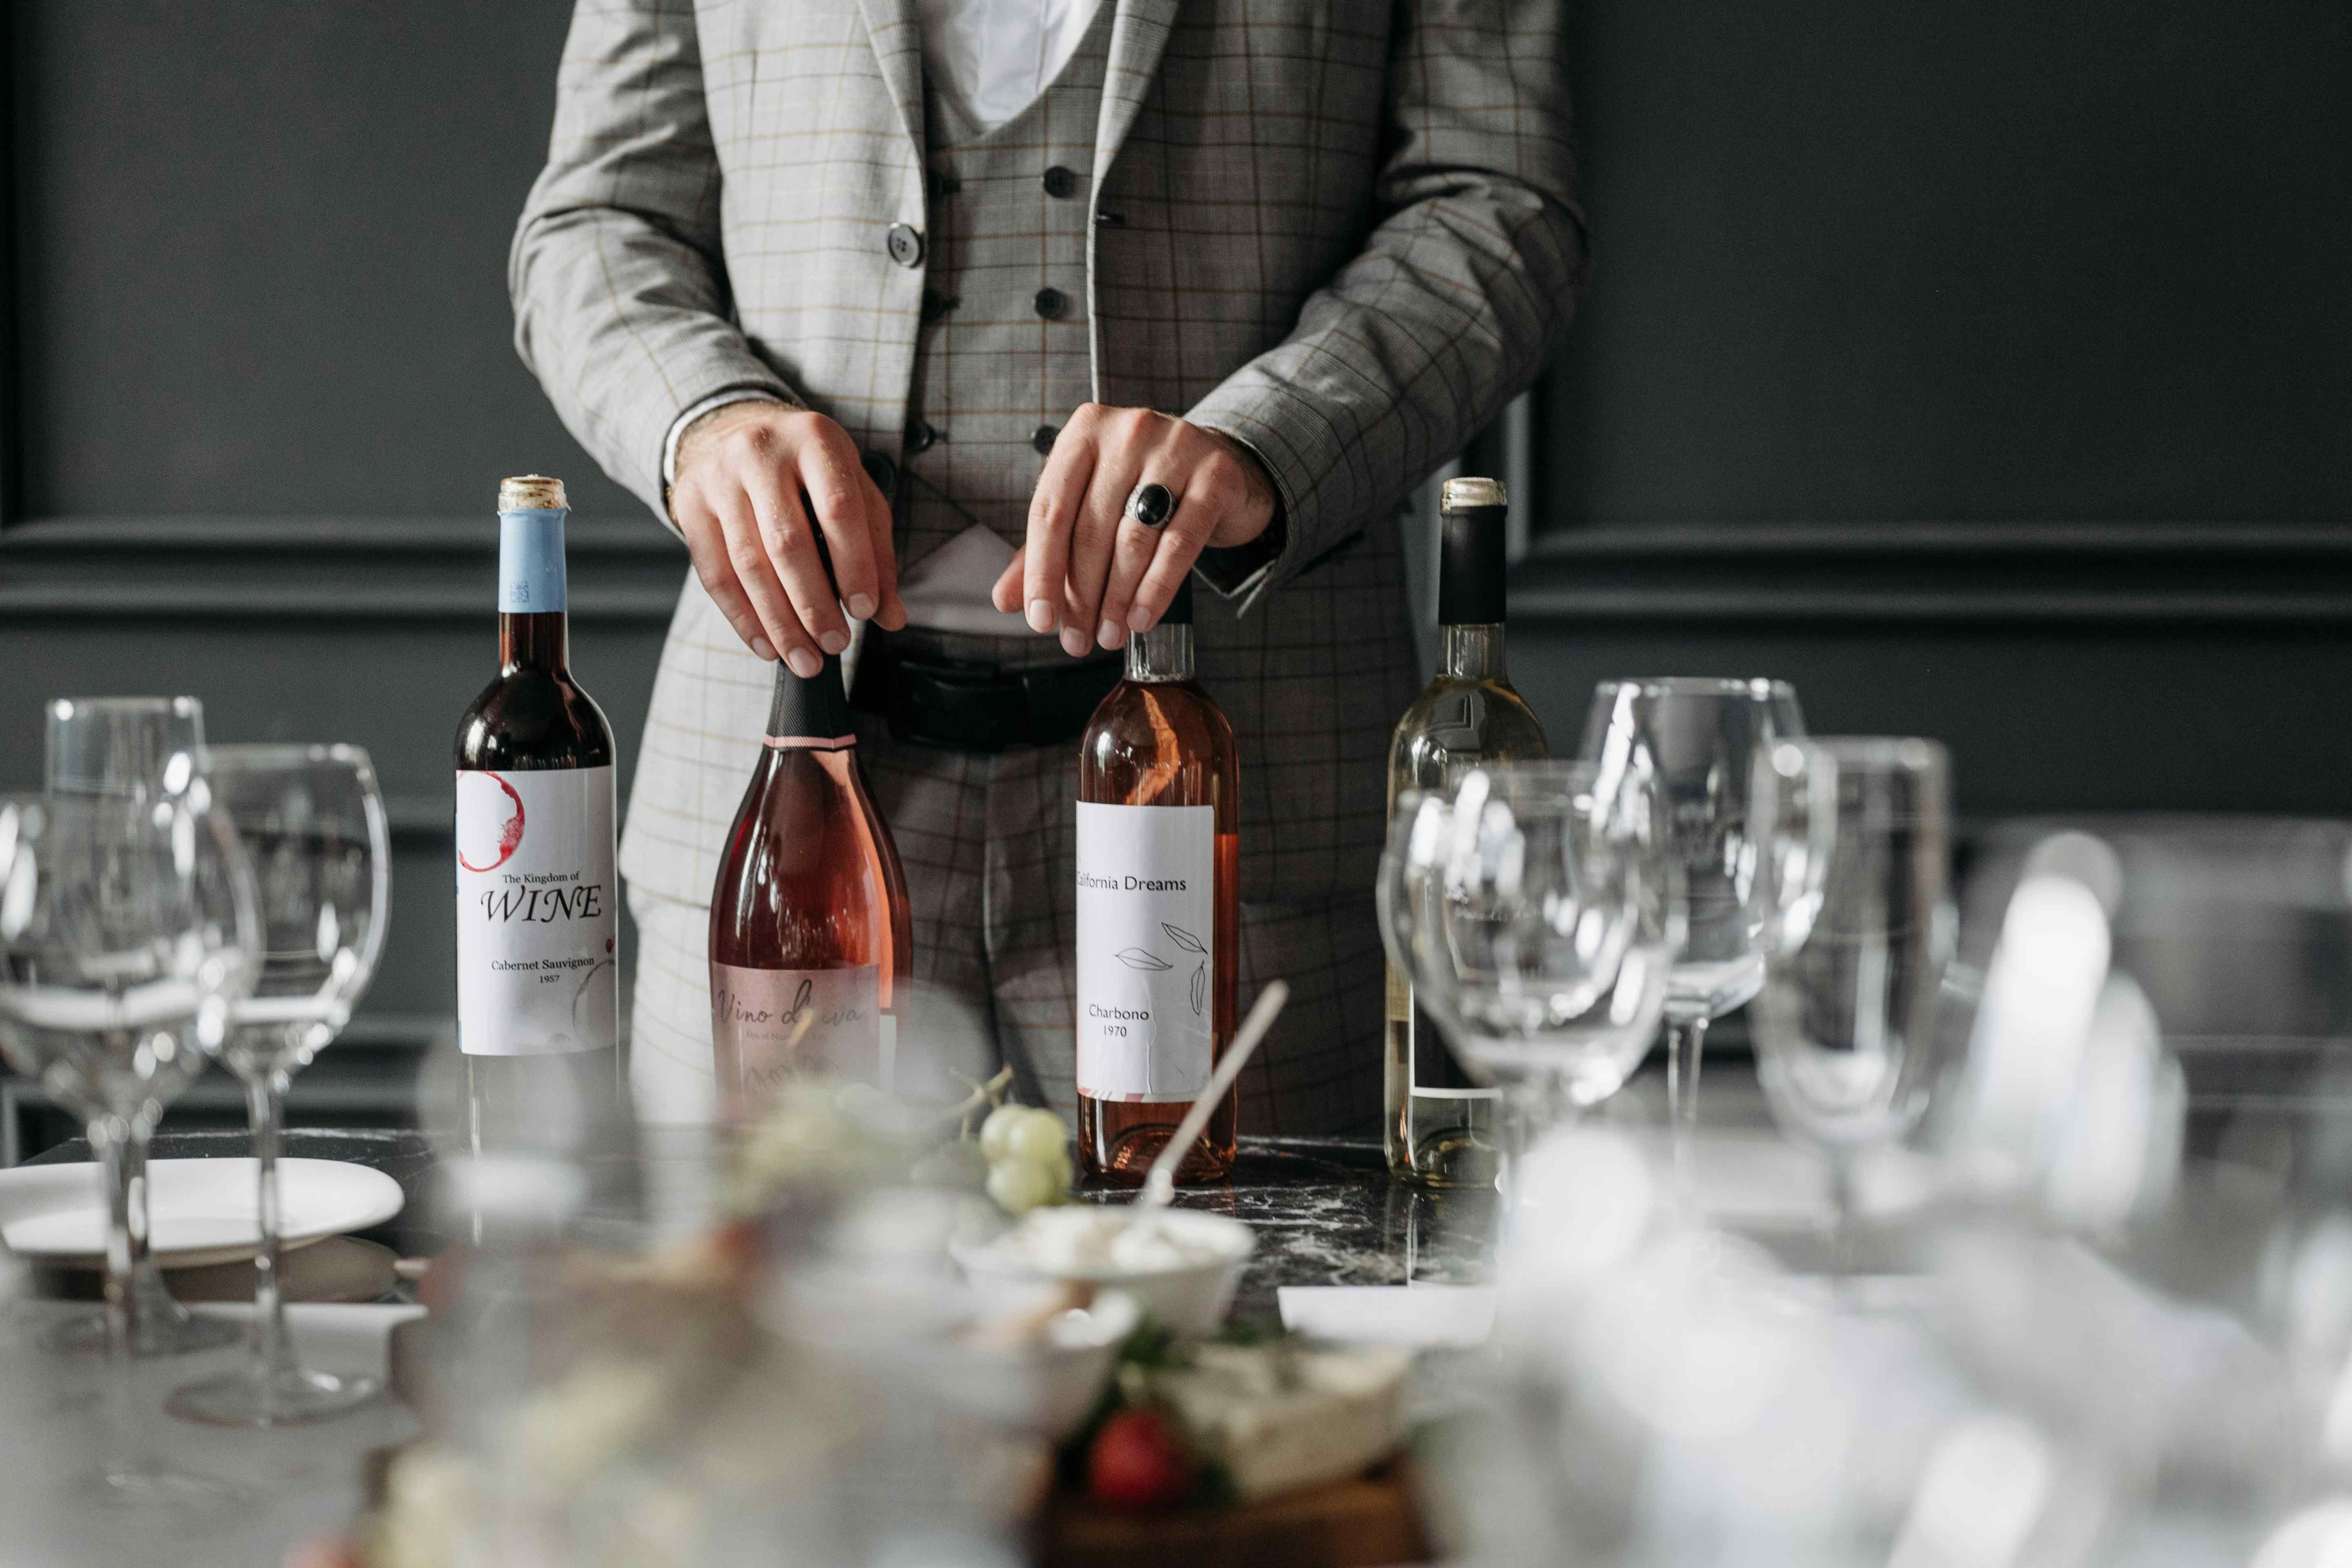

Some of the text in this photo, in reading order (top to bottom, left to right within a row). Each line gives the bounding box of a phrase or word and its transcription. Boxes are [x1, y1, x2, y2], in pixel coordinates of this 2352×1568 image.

[502, 871, 580, 884] The Kingdom of
[1125, 876, 1186, 891] Dreams
[481, 885, 601, 923] WINE
[492, 957, 595, 970] Cabernet Sauvignon
[539, 975, 560, 984] 1957
[718, 989, 774, 1023] Vino
[1089, 1004, 1149, 1020] Charbono
[1104, 1025, 1127, 1037] 1970
